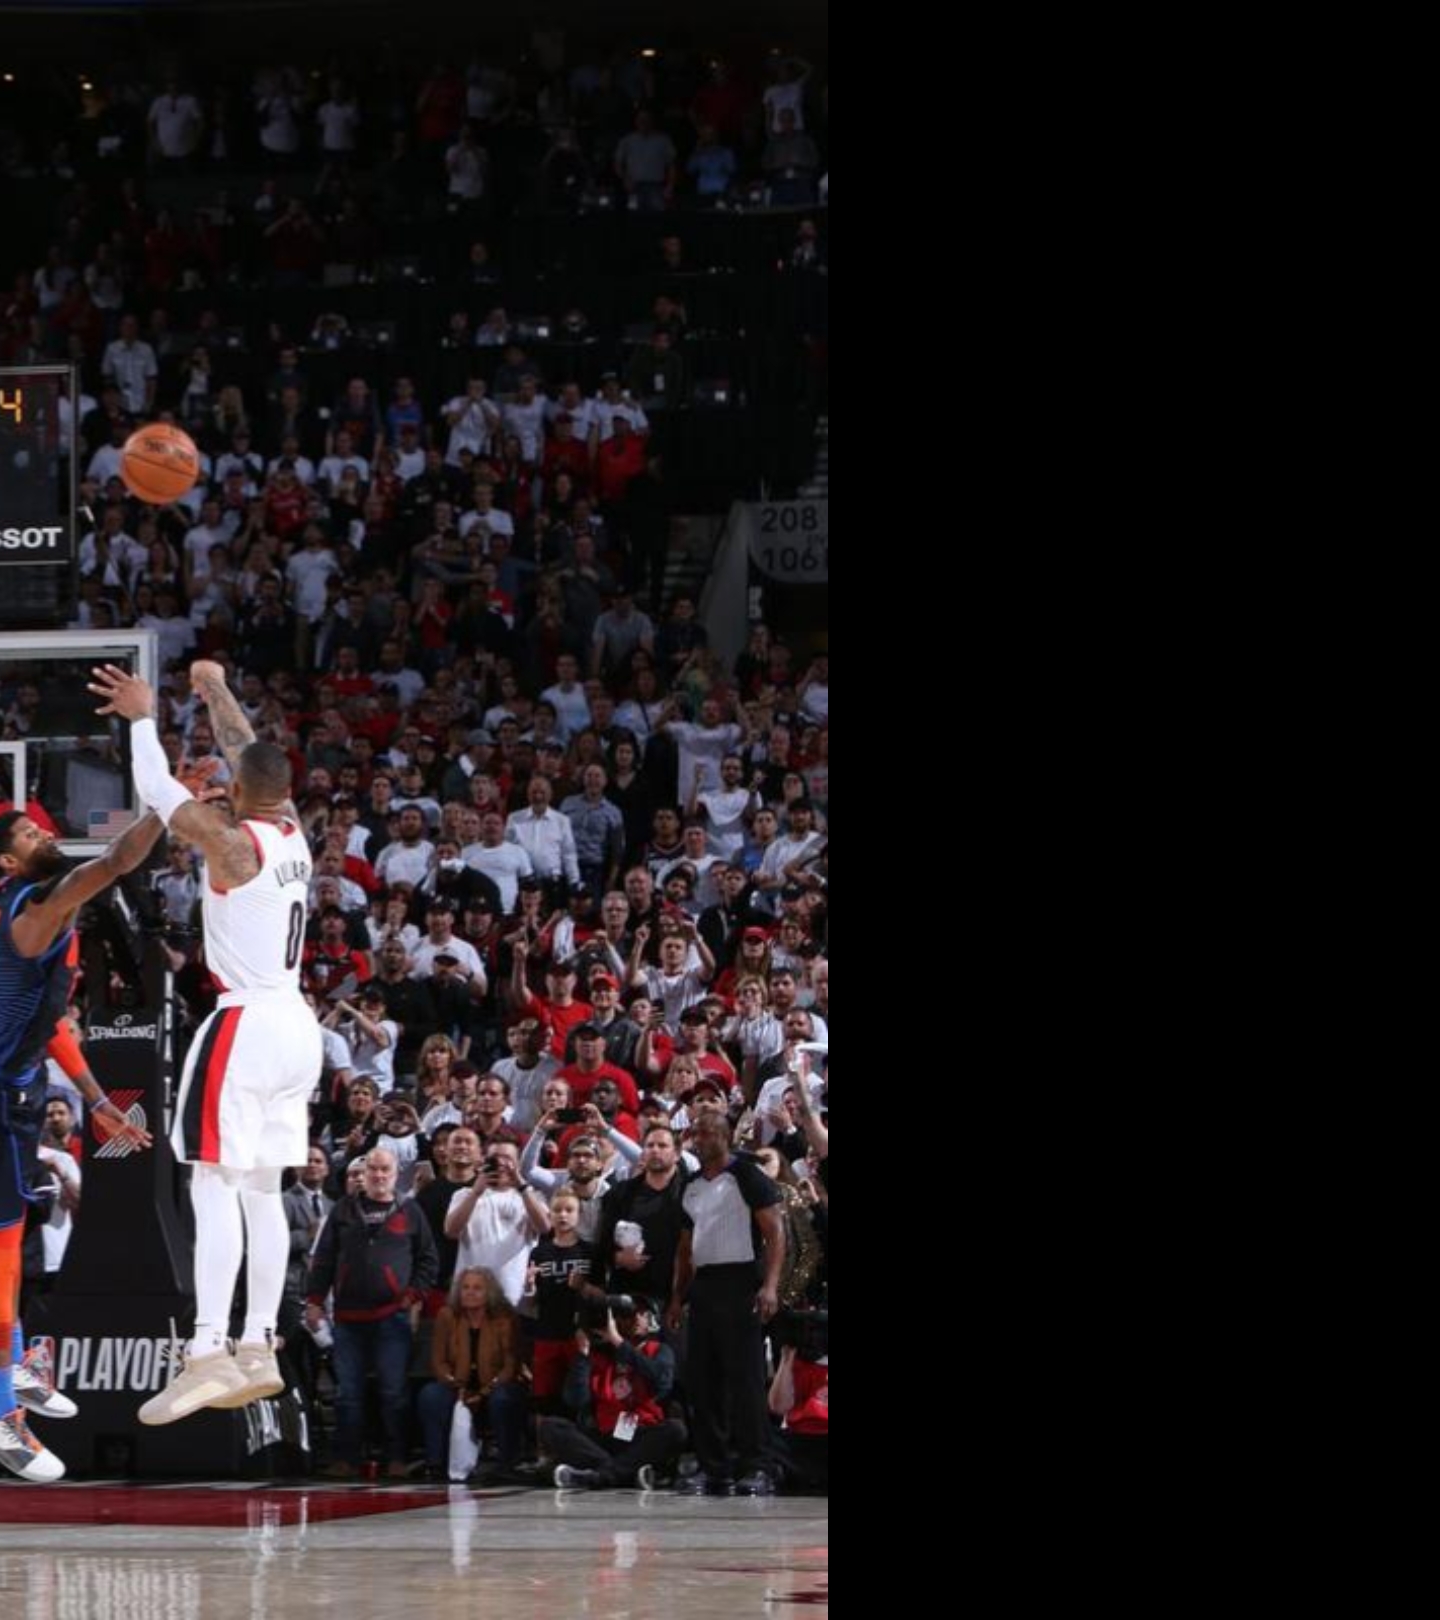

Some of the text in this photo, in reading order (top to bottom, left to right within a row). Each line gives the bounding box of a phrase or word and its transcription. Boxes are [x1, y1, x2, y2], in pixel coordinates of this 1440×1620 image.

[761, 506, 817, 532] 208
[762, 547, 818, 571] 106
[285, 900, 304, 970] 0
[88, 1024, 157, 1041] SPALDING
[57, 1337, 192, 1391] PLAYOFF
